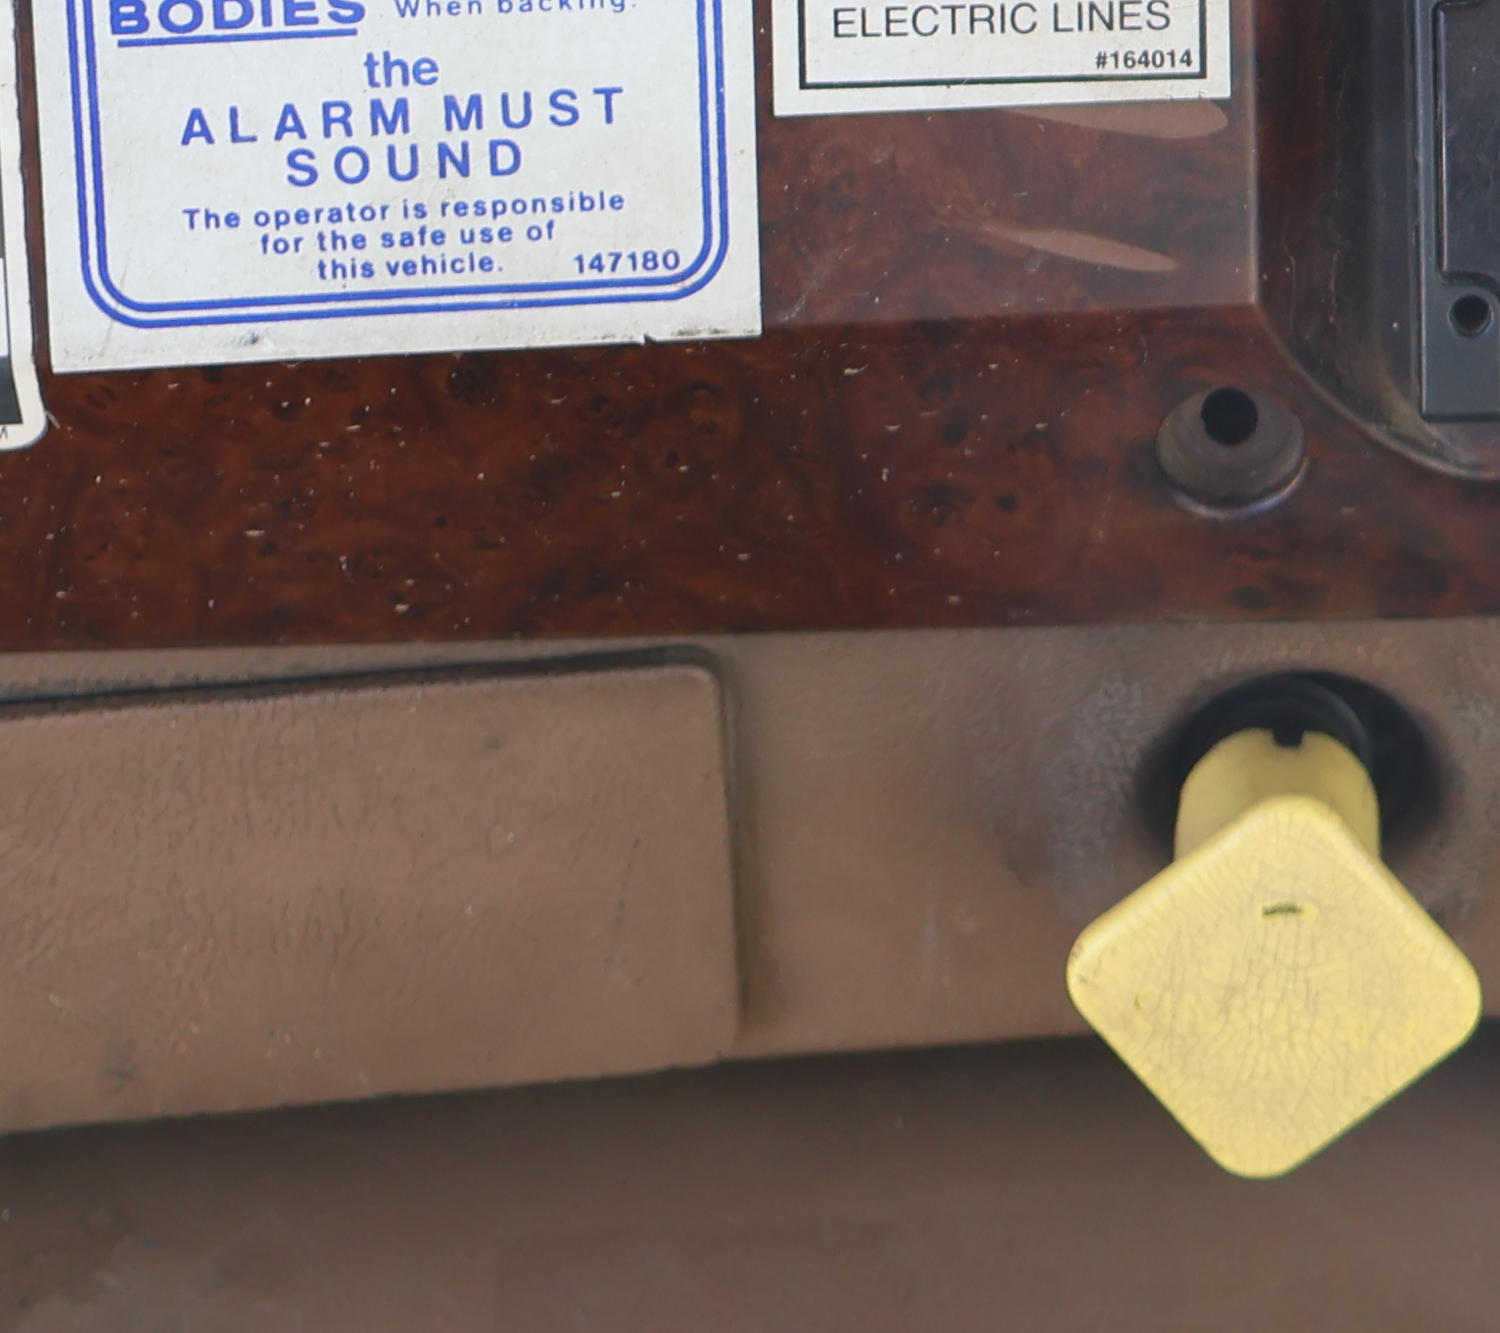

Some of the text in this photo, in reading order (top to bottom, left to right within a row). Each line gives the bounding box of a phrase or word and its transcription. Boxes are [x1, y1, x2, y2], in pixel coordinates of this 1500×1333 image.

[833, 2, 1038, 39] ELECTRIC
[364, 52, 439, 89] the
[1095, 49, 1193, 70] #164014
[181, 87, 625, 146] ALARM MUST
[286, 138, 523, 188] SOUND
[183, 190, 625, 232] The operator is responsible
[260, 219, 557, 254] for the safe use of
[316, 251, 506, 280] this vehicle.
[574, 249, 681, 274] 147180
